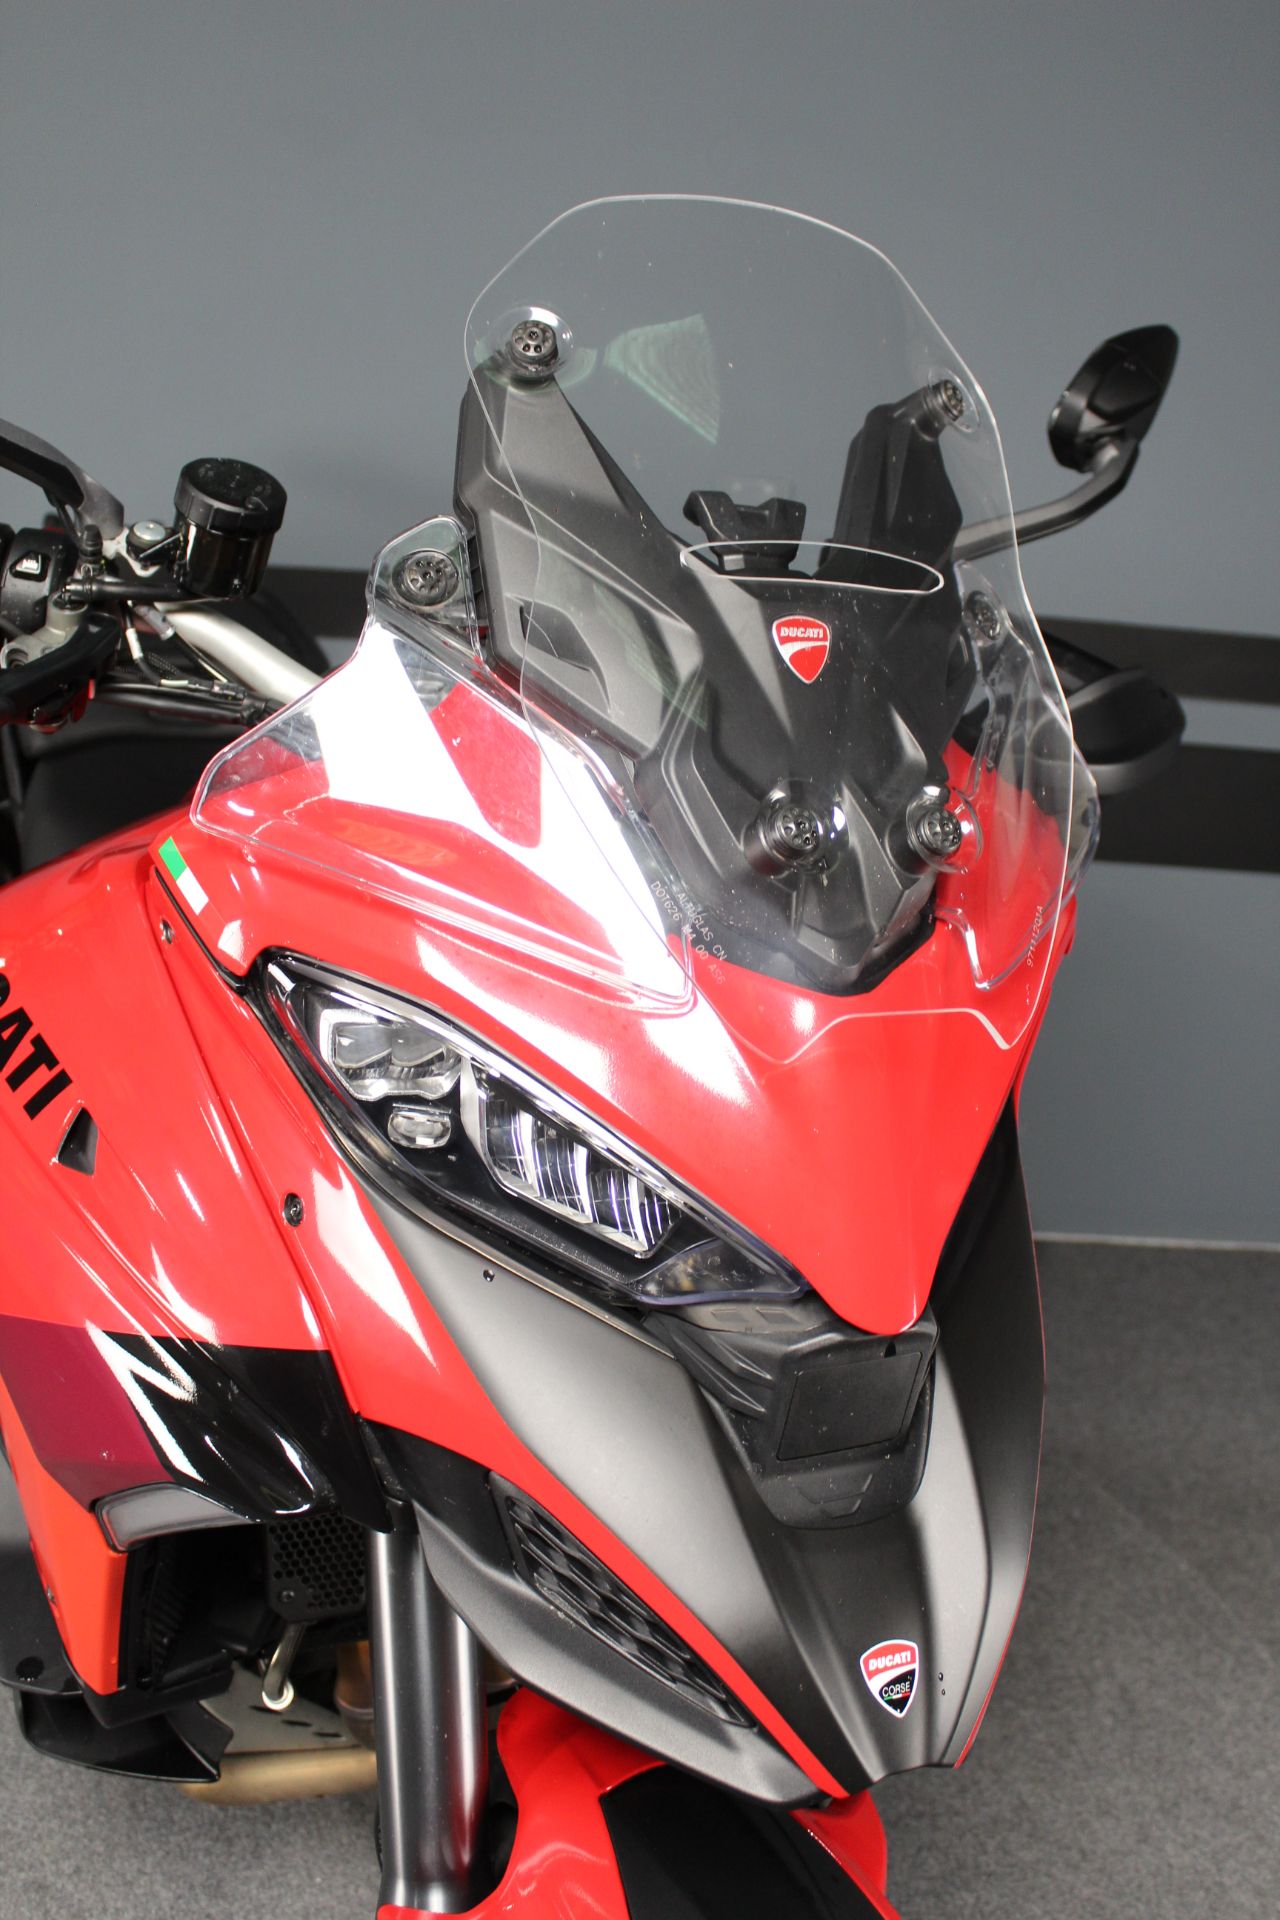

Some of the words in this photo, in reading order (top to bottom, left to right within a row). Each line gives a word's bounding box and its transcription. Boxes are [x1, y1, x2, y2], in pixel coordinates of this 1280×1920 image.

[780, 626, 824, 639] DUCATI
[650, 880, 683, 921] DOT626
[677, 893, 714, 942] ALTUGLAS
[712, 944, 728, 961] CN
[0, 972, 73, 1121] ATI
[868, 1650, 911, 1671] DUCATI
[881, 1681, 911, 1697] CORSE
